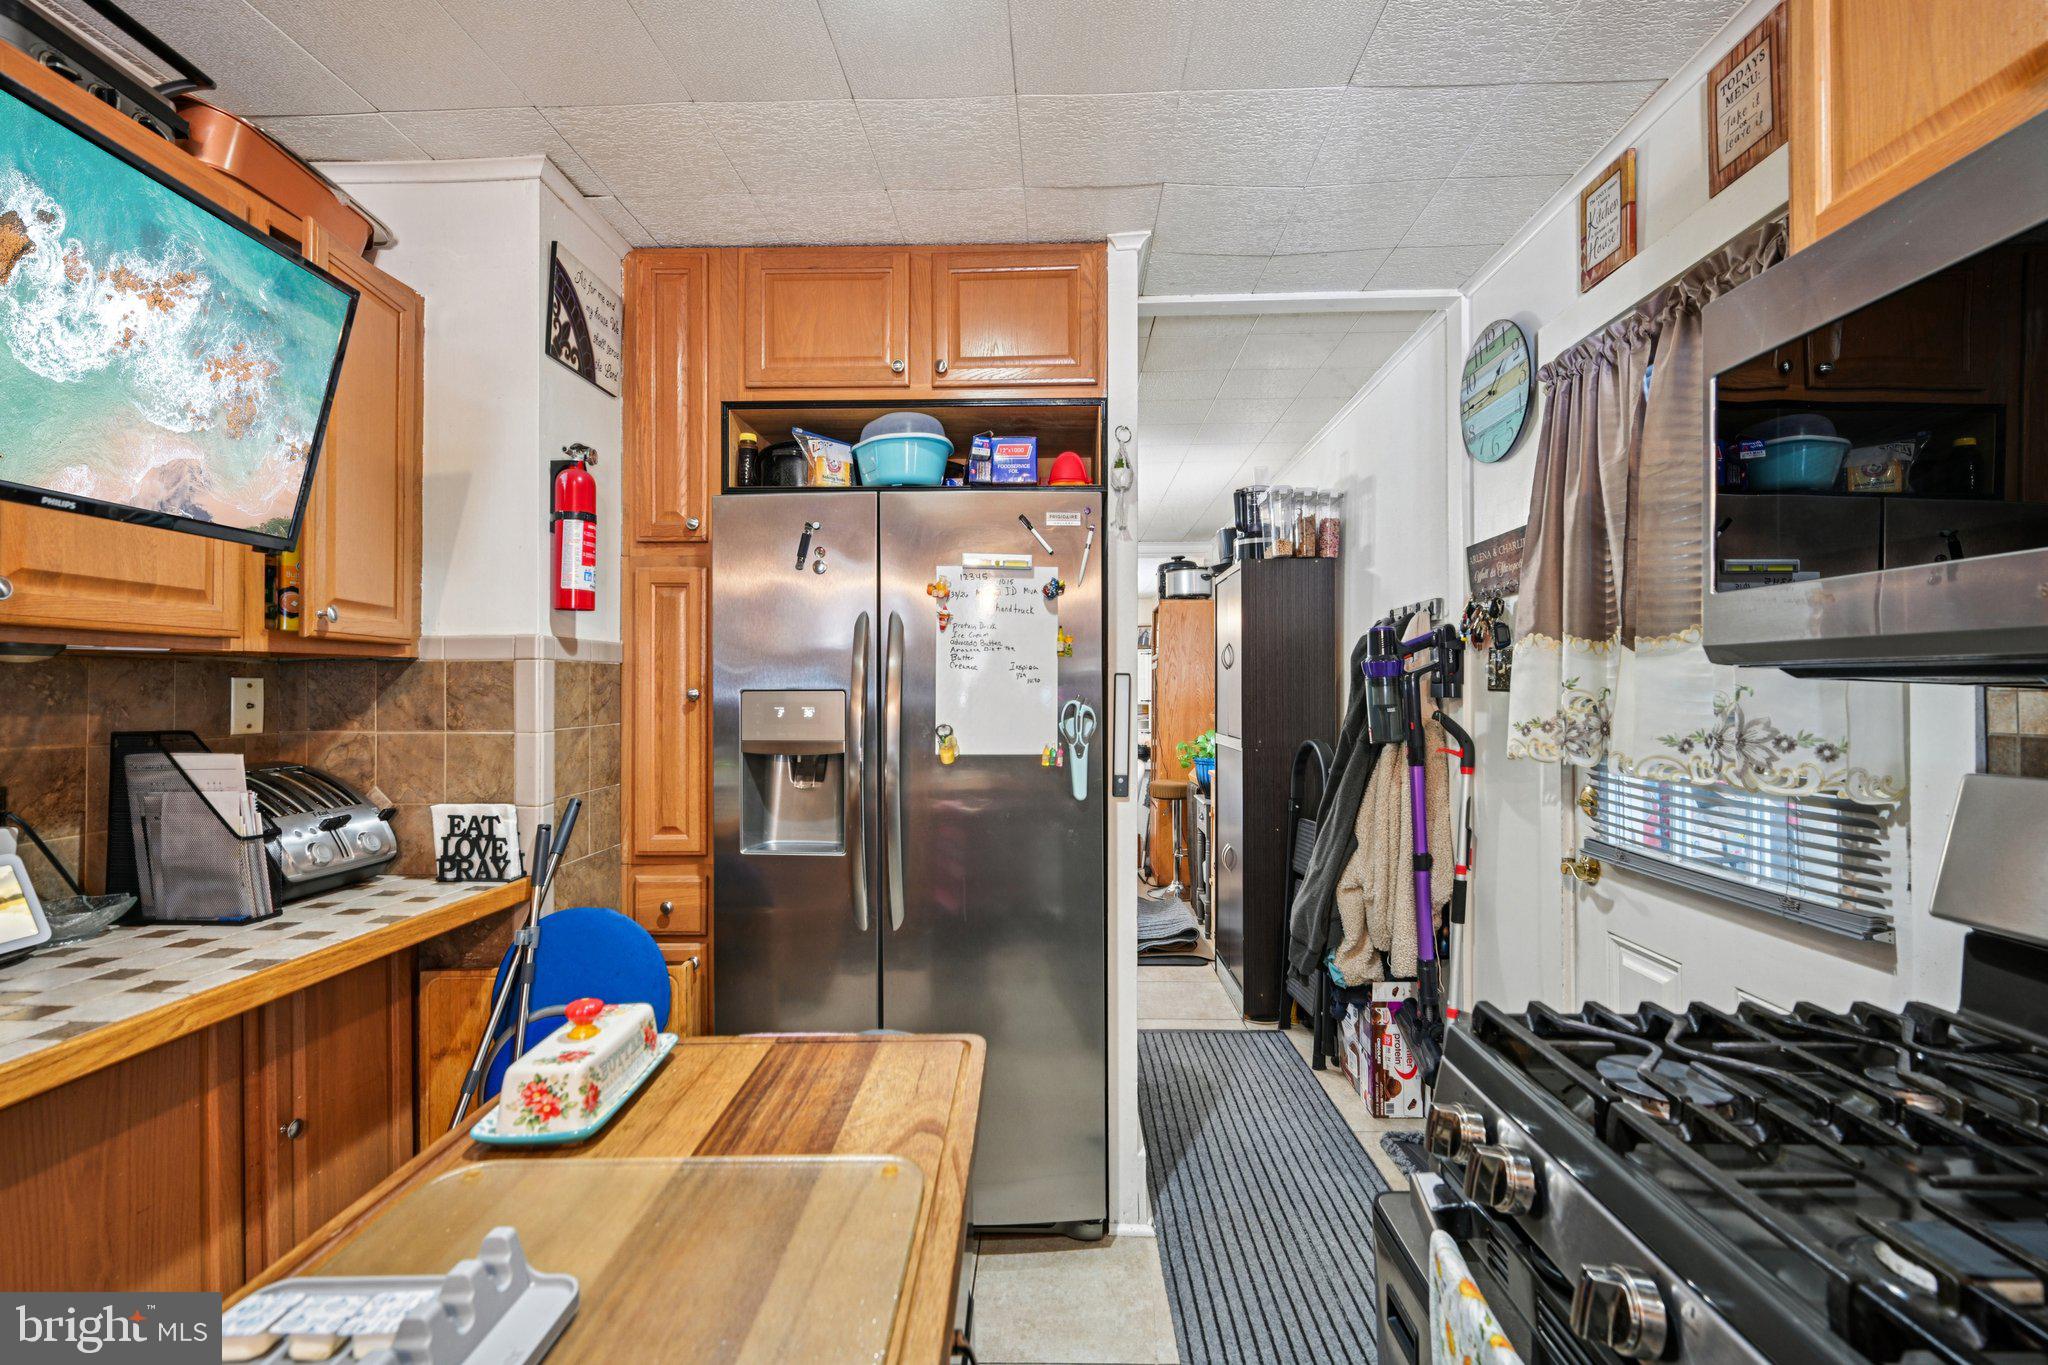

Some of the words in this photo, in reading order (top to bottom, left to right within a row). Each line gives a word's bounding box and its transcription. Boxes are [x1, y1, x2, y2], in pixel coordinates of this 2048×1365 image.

[1720, 48, 1766, 97] TODAYS
[1725, 70, 1760, 108] MENU:
[1752, 92, 1760, 109] it
[1755, 110, 1764, 126] it
[1588, 198, 1619, 240] Kitchen
[1589, 233, 1616, 265] House
[574, 270, 587, 290] As
[587, 281, 597, 295] for
[597, 292, 605, 303] me
[606, 300, 616, 311] and
[586, 305, 593, 319] my
[594, 306, 608, 327] house
[1485, 328, 1496, 352] 12
[1474, 345, 1483, 369] 11
[1466, 372, 1477, 395] 10
[1519, 361, 1527, 385] 3
[41, 496, 77, 509] PHILIPS
[960, 573, 988, 581] 12345
[447, 815, 502, 837] EAT
[441, 836, 508, 860] LOVE
[436, 859, 511, 882] PRAY
[1393, 1033, 1402, 1065] protein
